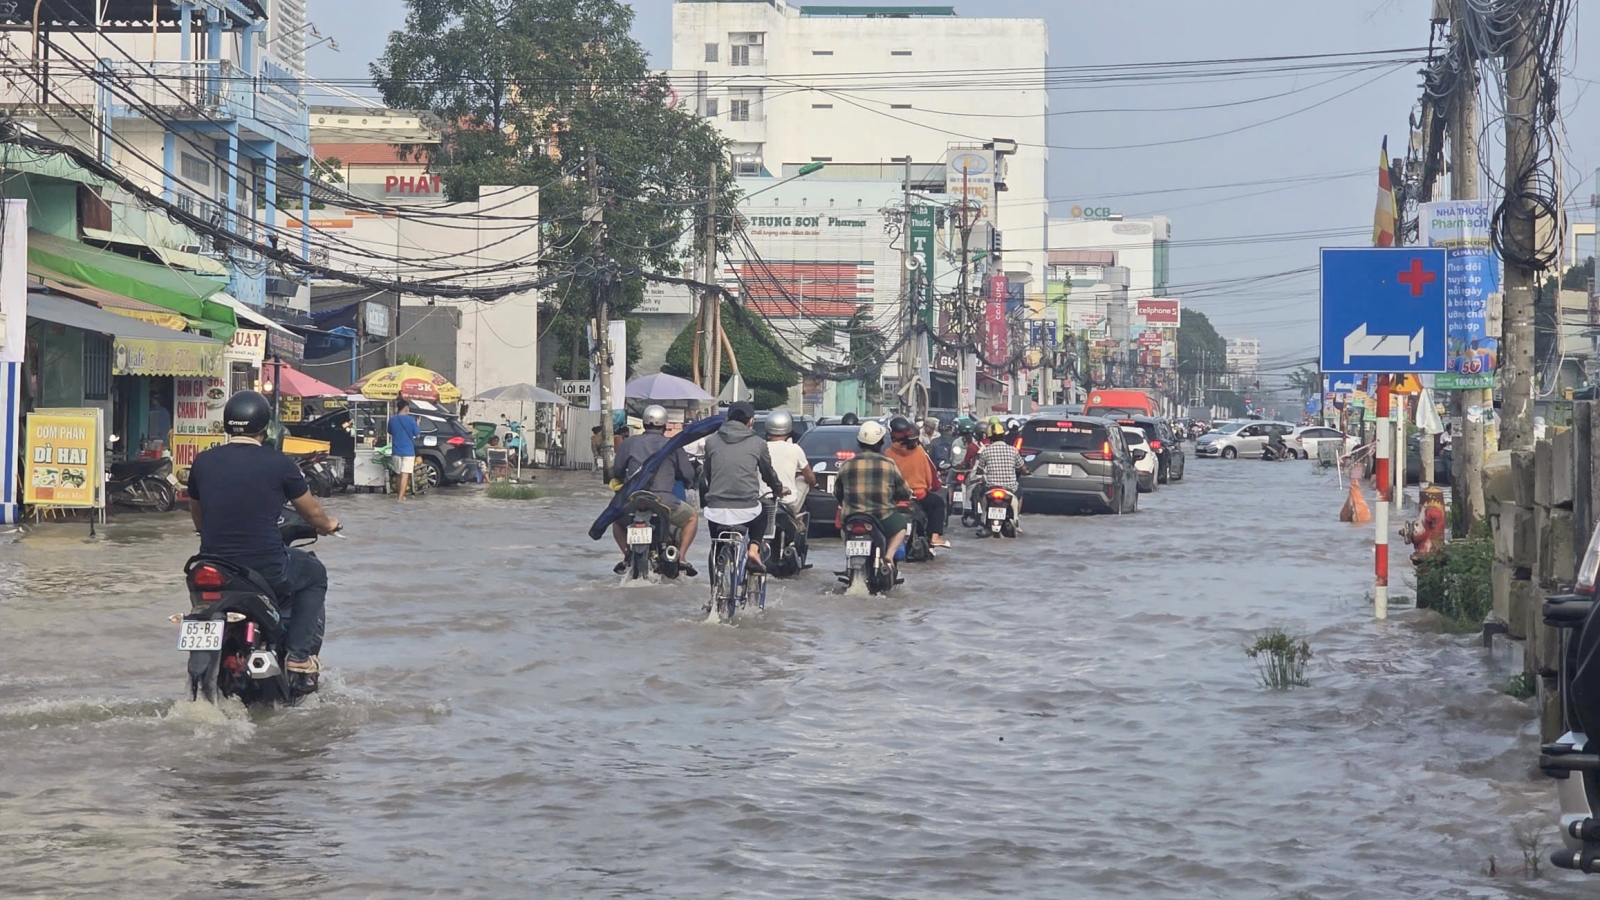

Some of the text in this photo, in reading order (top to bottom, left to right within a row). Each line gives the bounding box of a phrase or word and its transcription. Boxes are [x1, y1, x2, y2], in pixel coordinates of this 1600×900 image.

[385, 171, 442, 194] PHÁT
[1083, 207, 1111, 218] OCB
[1436, 207, 1456, 217] NHÀ
[750, 216, 792, 227] TRUNG
[828, 216, 867, 227] Pharma
[1465, 262, 1482, 271] dõi
[1468, 274, 1482, 285] áp
[228, 332, 262, 348] QUAY
[207, 379, 225, 387] 30k
[417, 383, 432, 391] 5K
[1455, 377, 1474, 386] 1800
[579, 385, 591, 394] RA
[177, 401, 198, 419] CHANH
[34, 443, 88, 465] DÌ HAI
[186, 623, 217, 635] 65-B2
[181, 636, 219, 648] 632.58
